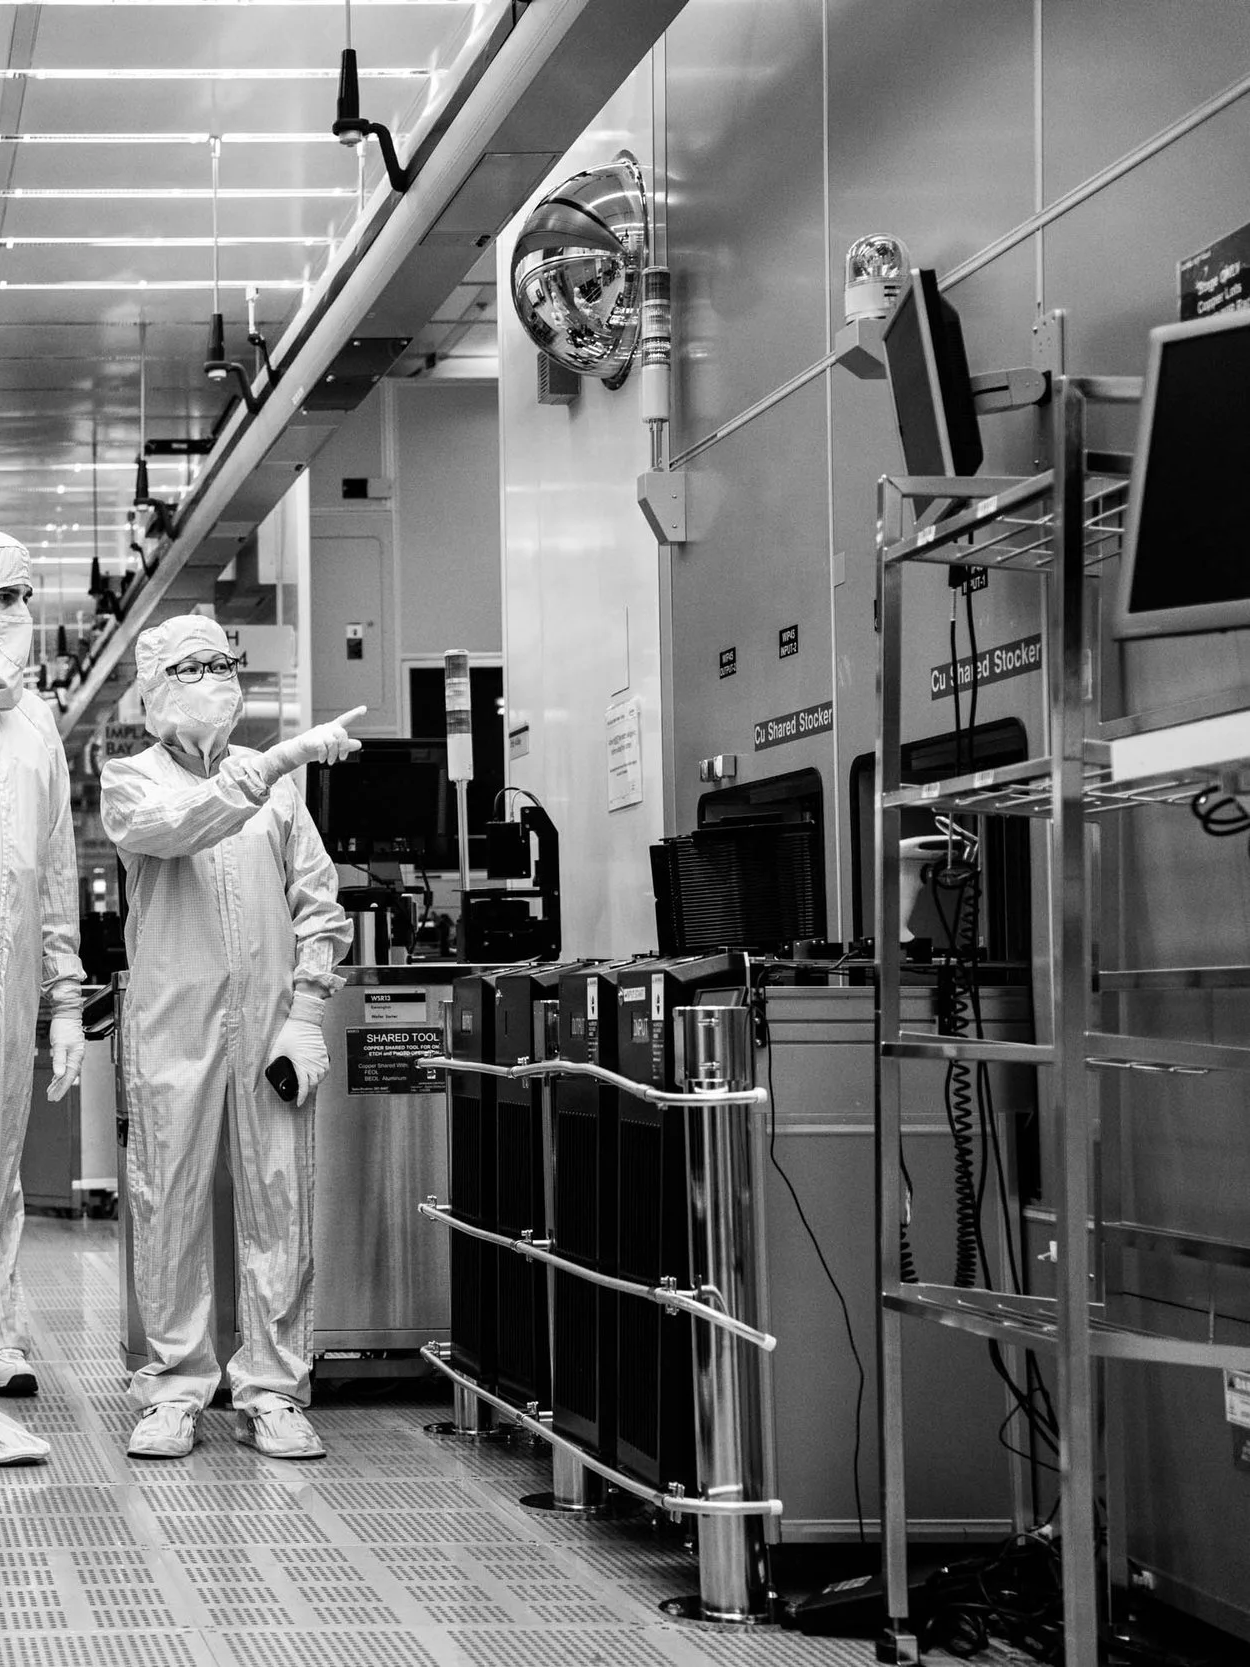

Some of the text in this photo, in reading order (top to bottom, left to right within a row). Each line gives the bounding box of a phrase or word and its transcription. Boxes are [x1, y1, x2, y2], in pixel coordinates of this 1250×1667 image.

[931, 669, 946, 693] Cu
[994, 642, 1041, 674] Stocker
[754, 707, 833, 745] Cu Shared Stocker
[106, 742, 134, 756] BAY
[366, 1032, 440, 1043] SHARED TOOL
